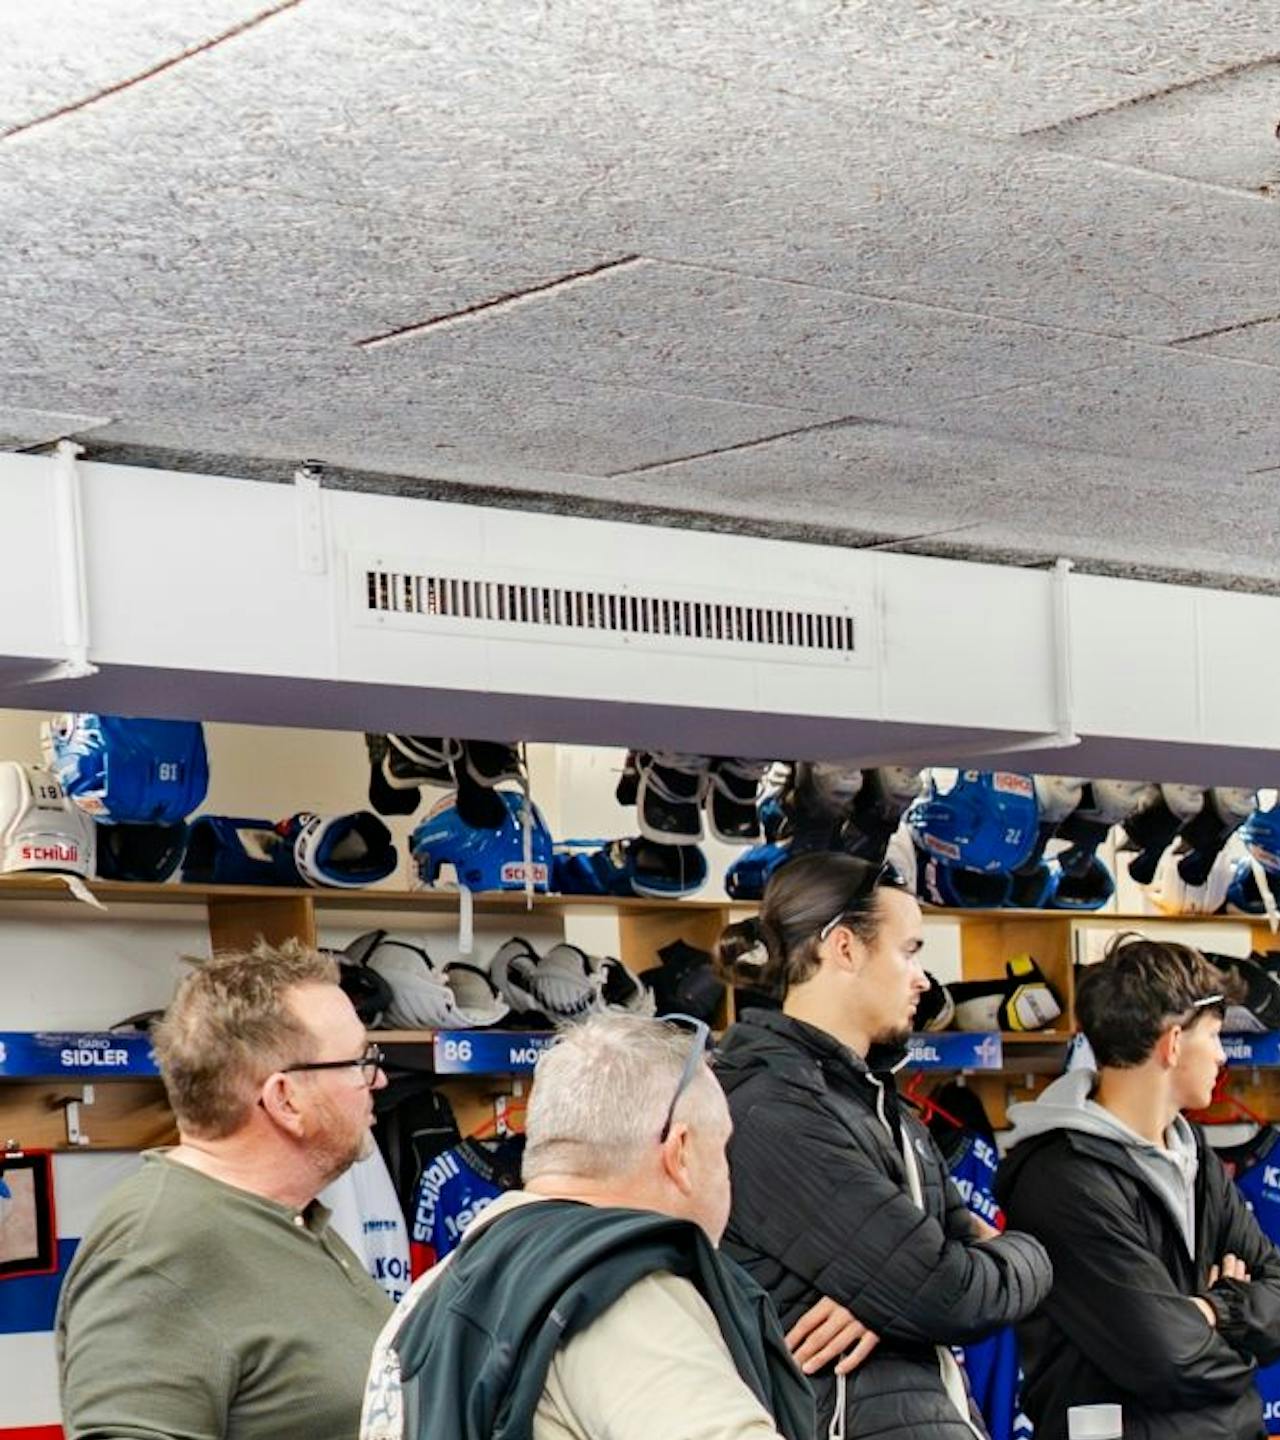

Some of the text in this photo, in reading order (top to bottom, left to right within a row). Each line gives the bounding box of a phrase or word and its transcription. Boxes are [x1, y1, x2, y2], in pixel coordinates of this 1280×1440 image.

[78, 1038, 110, 1049] DARIO
[444, 1039, 472, 1062] 86
[61, 1049, 129, 1067] SIDLER
